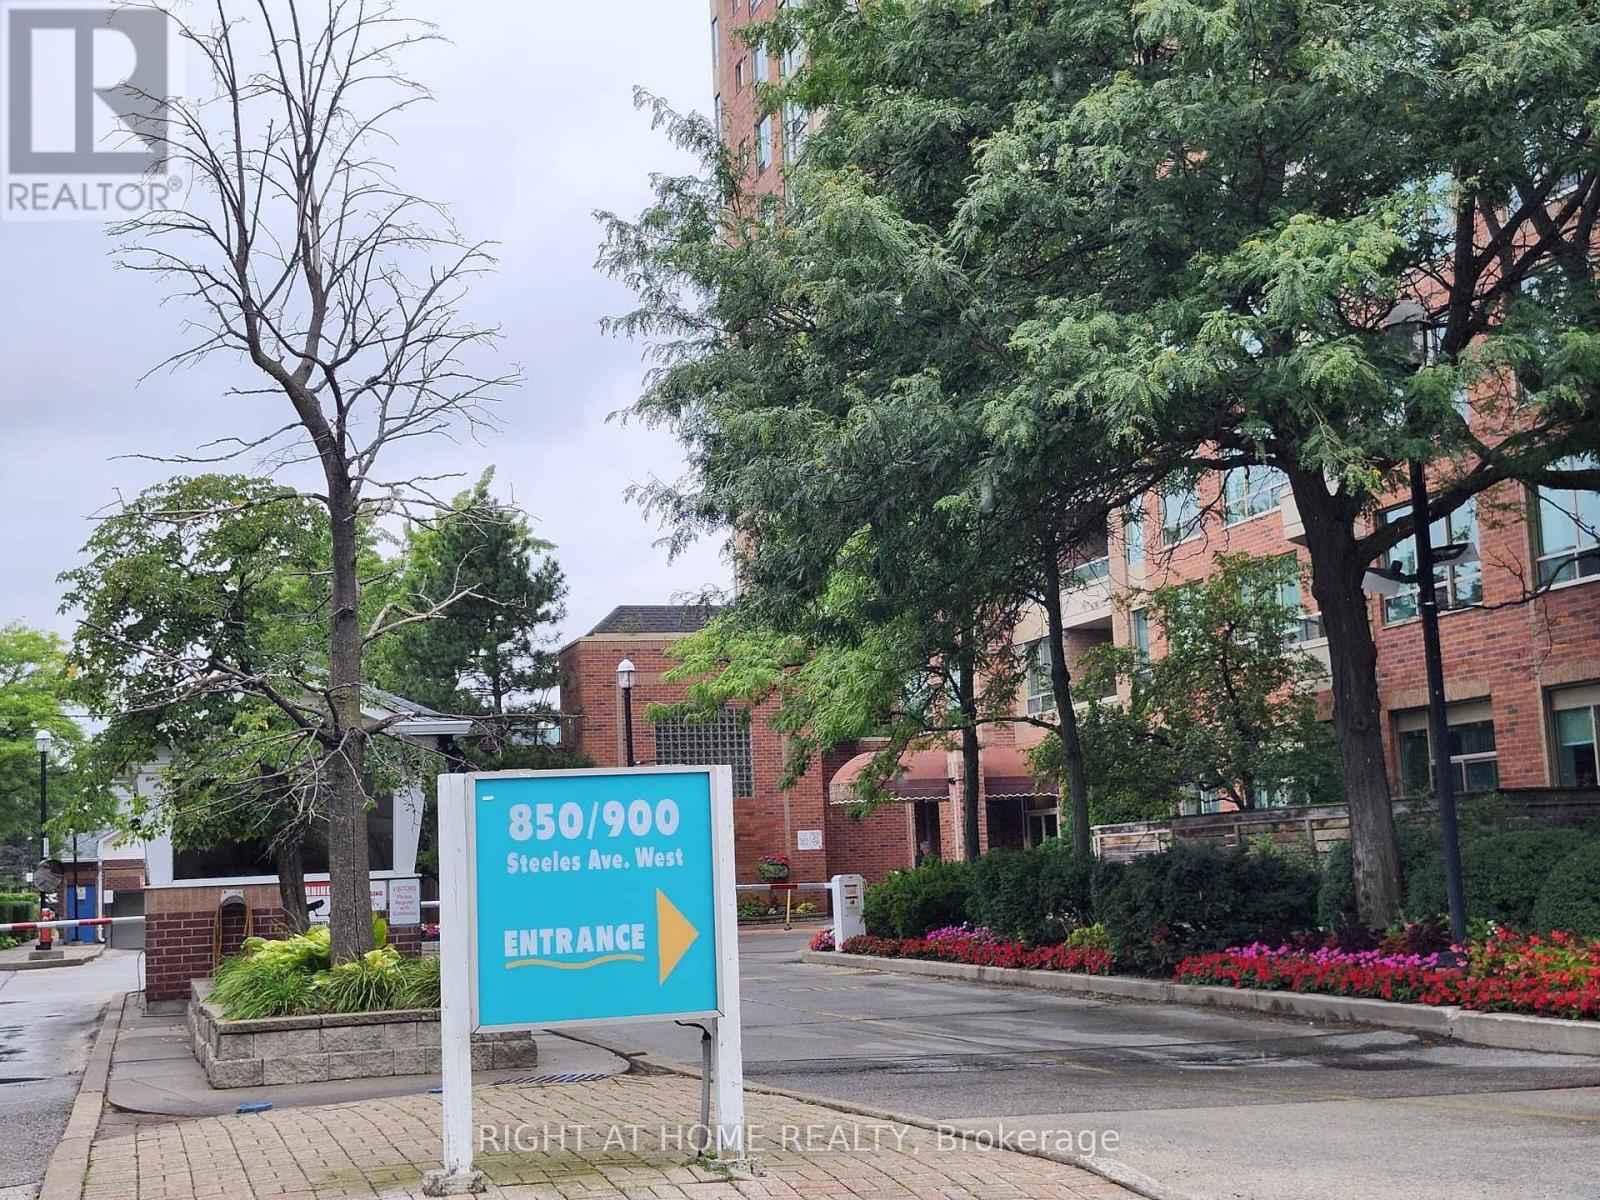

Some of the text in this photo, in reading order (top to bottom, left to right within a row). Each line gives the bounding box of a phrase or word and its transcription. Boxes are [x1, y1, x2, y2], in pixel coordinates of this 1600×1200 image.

[508, 799, 680, 841] 850/900
[506, 847, 684, 874] Steeles Ave. West
[504, 924, 645, 956] ENTRANCE
